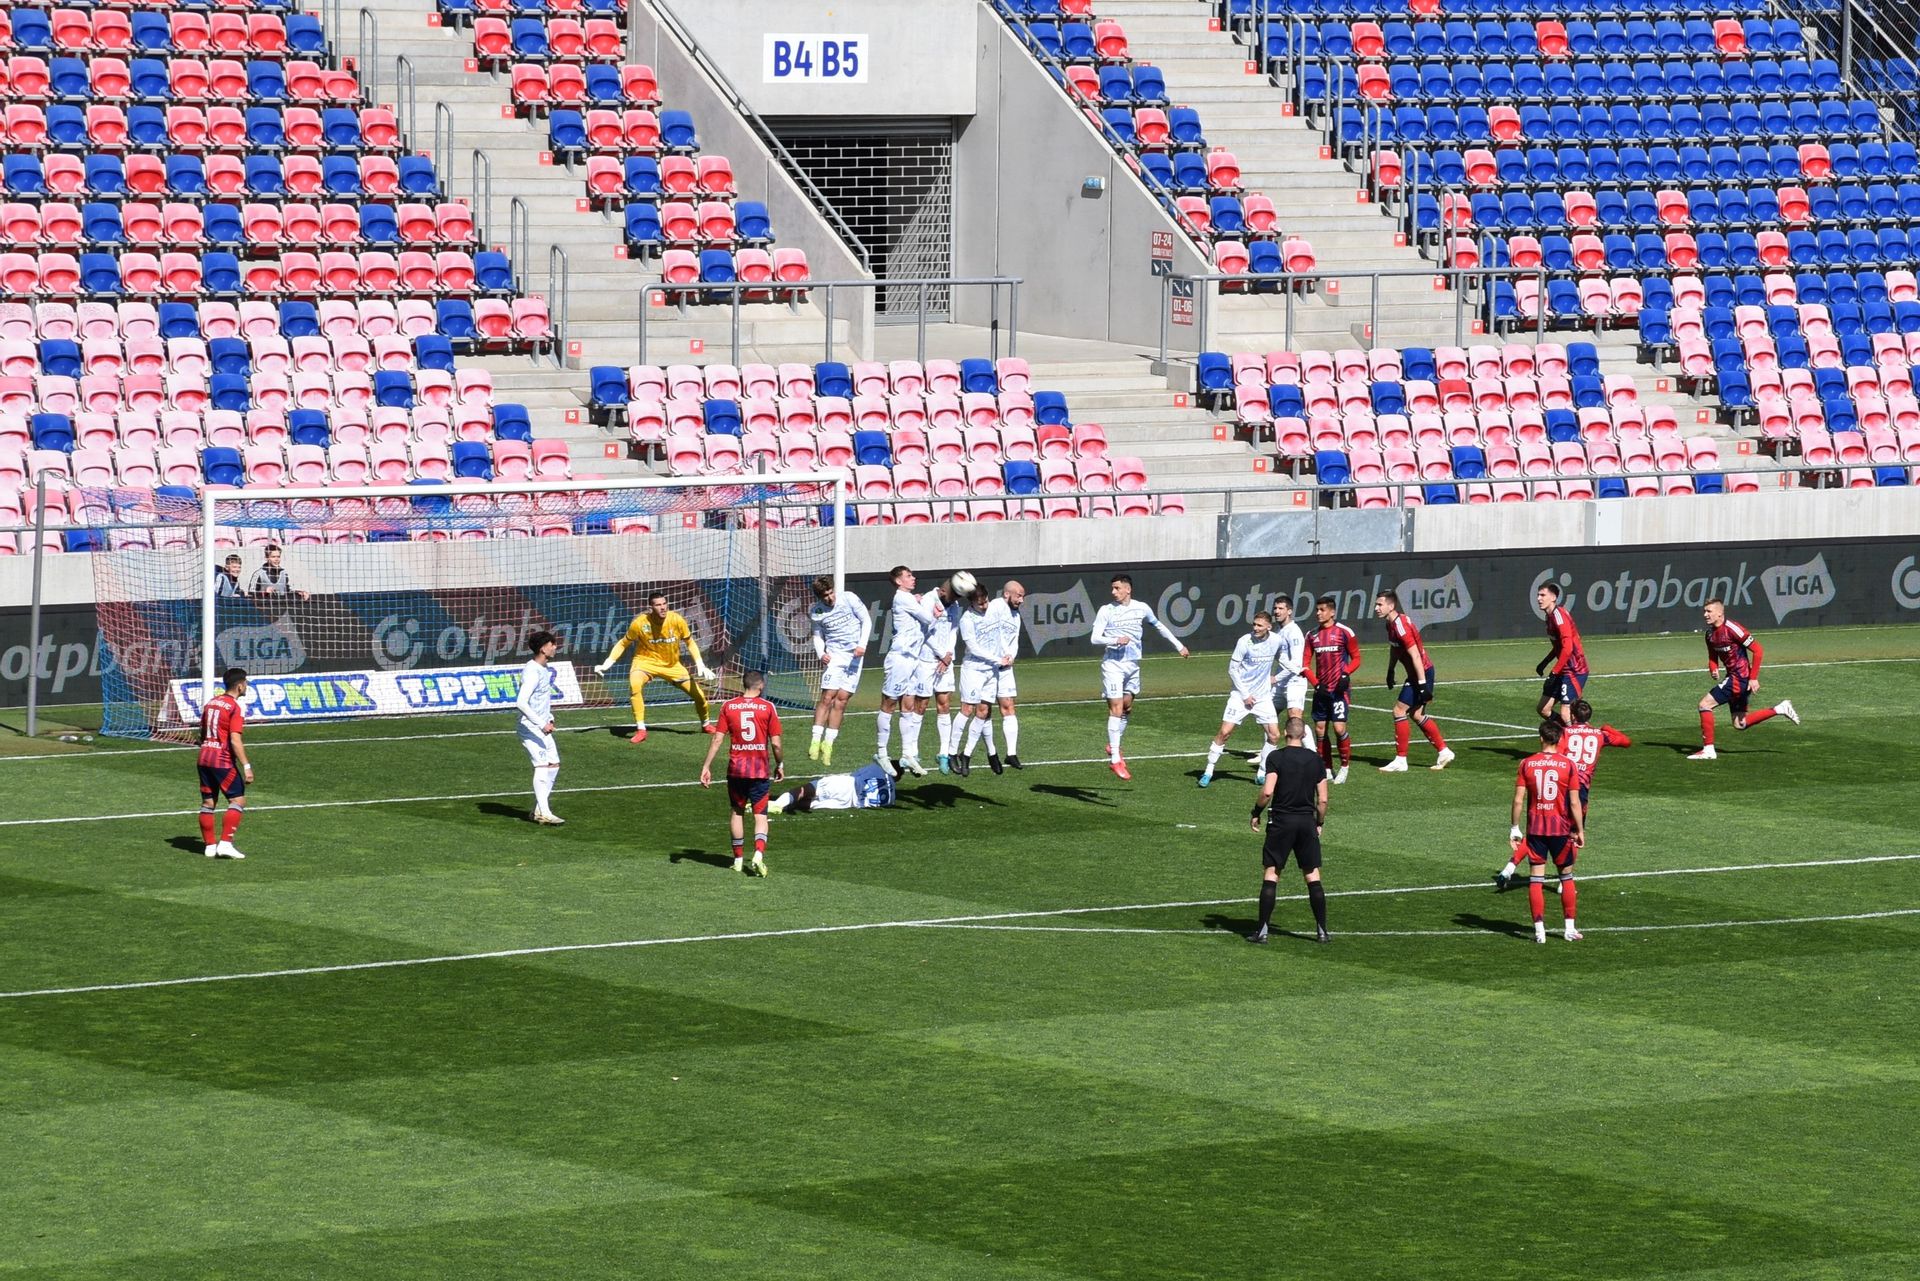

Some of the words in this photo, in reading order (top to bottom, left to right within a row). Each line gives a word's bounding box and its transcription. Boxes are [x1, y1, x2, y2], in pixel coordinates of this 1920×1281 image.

[773, 40, 813, 76] B4
[821, 40, 859, 76] B5
[1153, 233, 1173, 247] 07-24
[1173, 299, 1193, 313] 01-06
[1586, 561, 1758, 623] otpbank
[1775, 575, 1824, 596] LIGA
[1411, 588, 1461, 610] LIGA
[1033, 602, 1085, 626] LIGA
[233, 637, 292, 661] LIGA
[758, 703, 767, 711] FC
[1332, 701, 1345, 714] 23
[206, 708, 220, 739] 11
[740, 711, 756, 742] 5
[1566, 735, 1598, 765] 99
[1558, 761, 1567, 769] FC
[1533, 769, 1559, 801] 16
